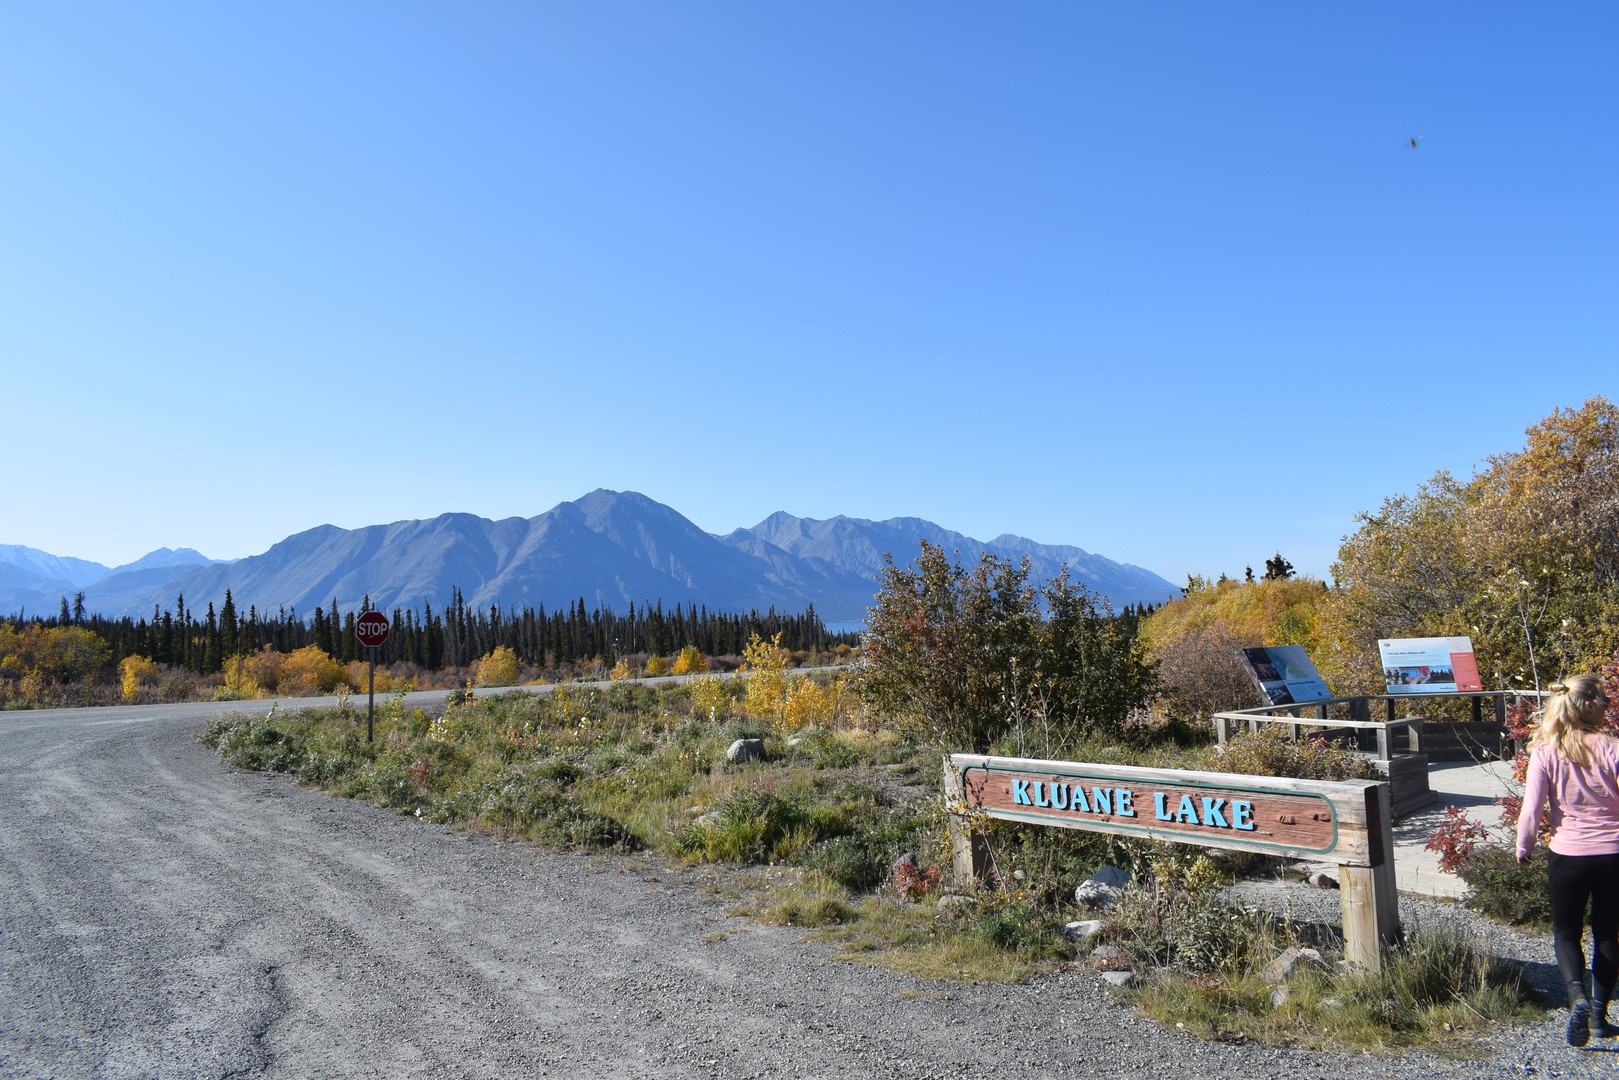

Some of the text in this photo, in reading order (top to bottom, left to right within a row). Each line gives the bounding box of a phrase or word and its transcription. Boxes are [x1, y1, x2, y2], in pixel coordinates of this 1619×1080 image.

[358, 621, 388, 636] STOP
[1011, 779, 1255, 831] KLUANE LAKE
